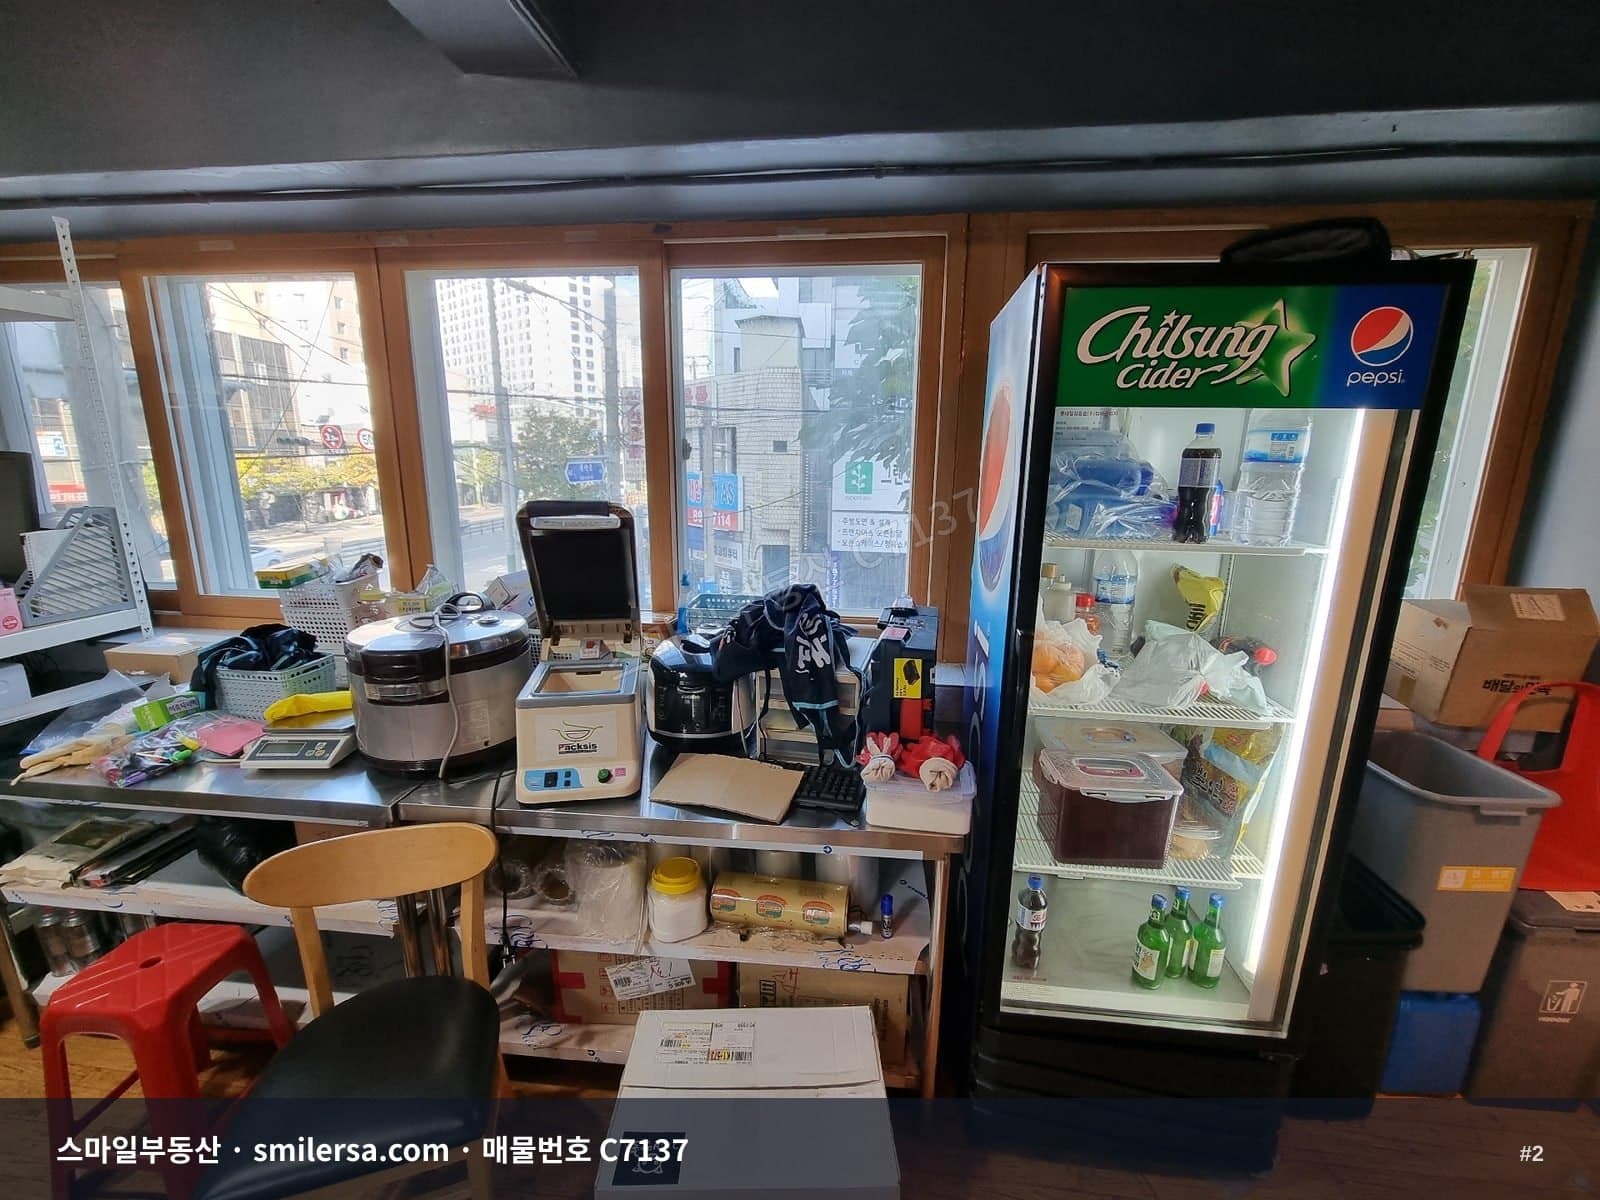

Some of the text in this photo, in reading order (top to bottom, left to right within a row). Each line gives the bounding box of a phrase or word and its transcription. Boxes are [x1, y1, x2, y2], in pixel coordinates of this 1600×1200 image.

[1077, 306, 1278, 385] Chilsung
[1116, 359, 1229, 389] Cider
[1347, 369, 1403, 387] pepsi
[558, 742, 598, 751] Packsis
